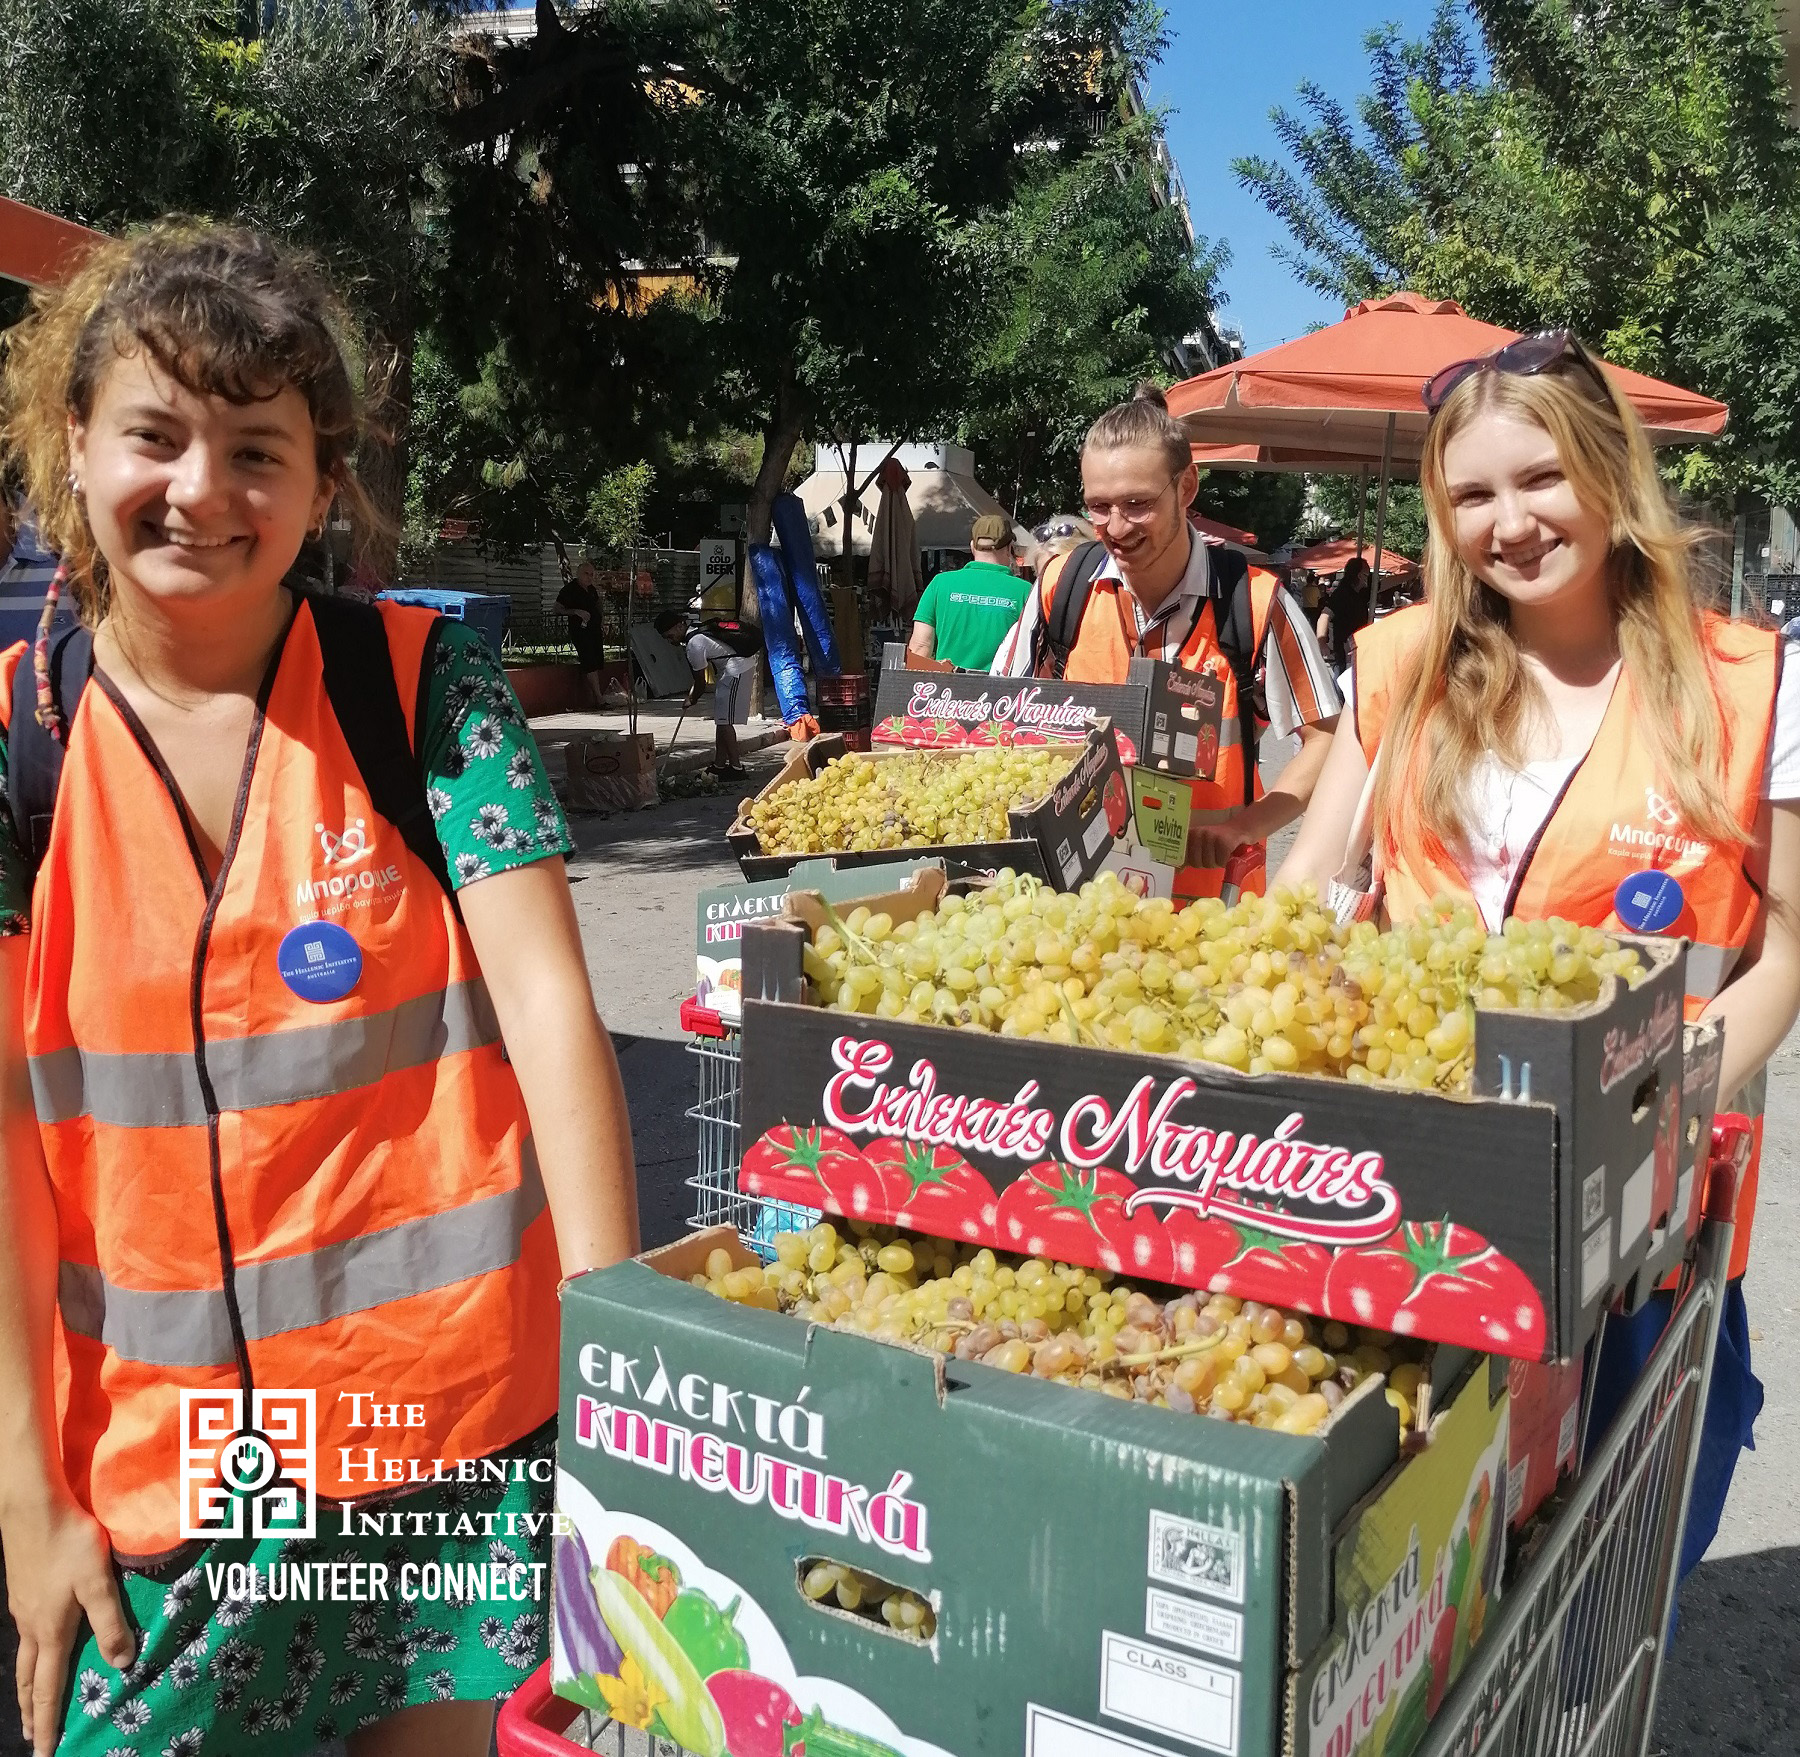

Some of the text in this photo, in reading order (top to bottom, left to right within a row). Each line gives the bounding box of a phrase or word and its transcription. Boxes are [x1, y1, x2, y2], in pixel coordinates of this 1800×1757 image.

[706, 563, 734, 575] BEER
[709, 555, 731, 563] COLD
[950, 592, 1017, 609] SPEEDEX
[907, 681, 991, 722] Εκλεκτές
[1153, 816, 1183, 840] velvita
[822, 1036, 1401, 1246] Εκλεκτές Ντομάτες
[579, 1343, 828, 1460] εκλεκτά
[576, 1394, 932, 1564] κηπευτικά
[1126, 1649, 1188, 1680] CLASS
[1320, 1546, 1444, 1757] ηπευτικά
